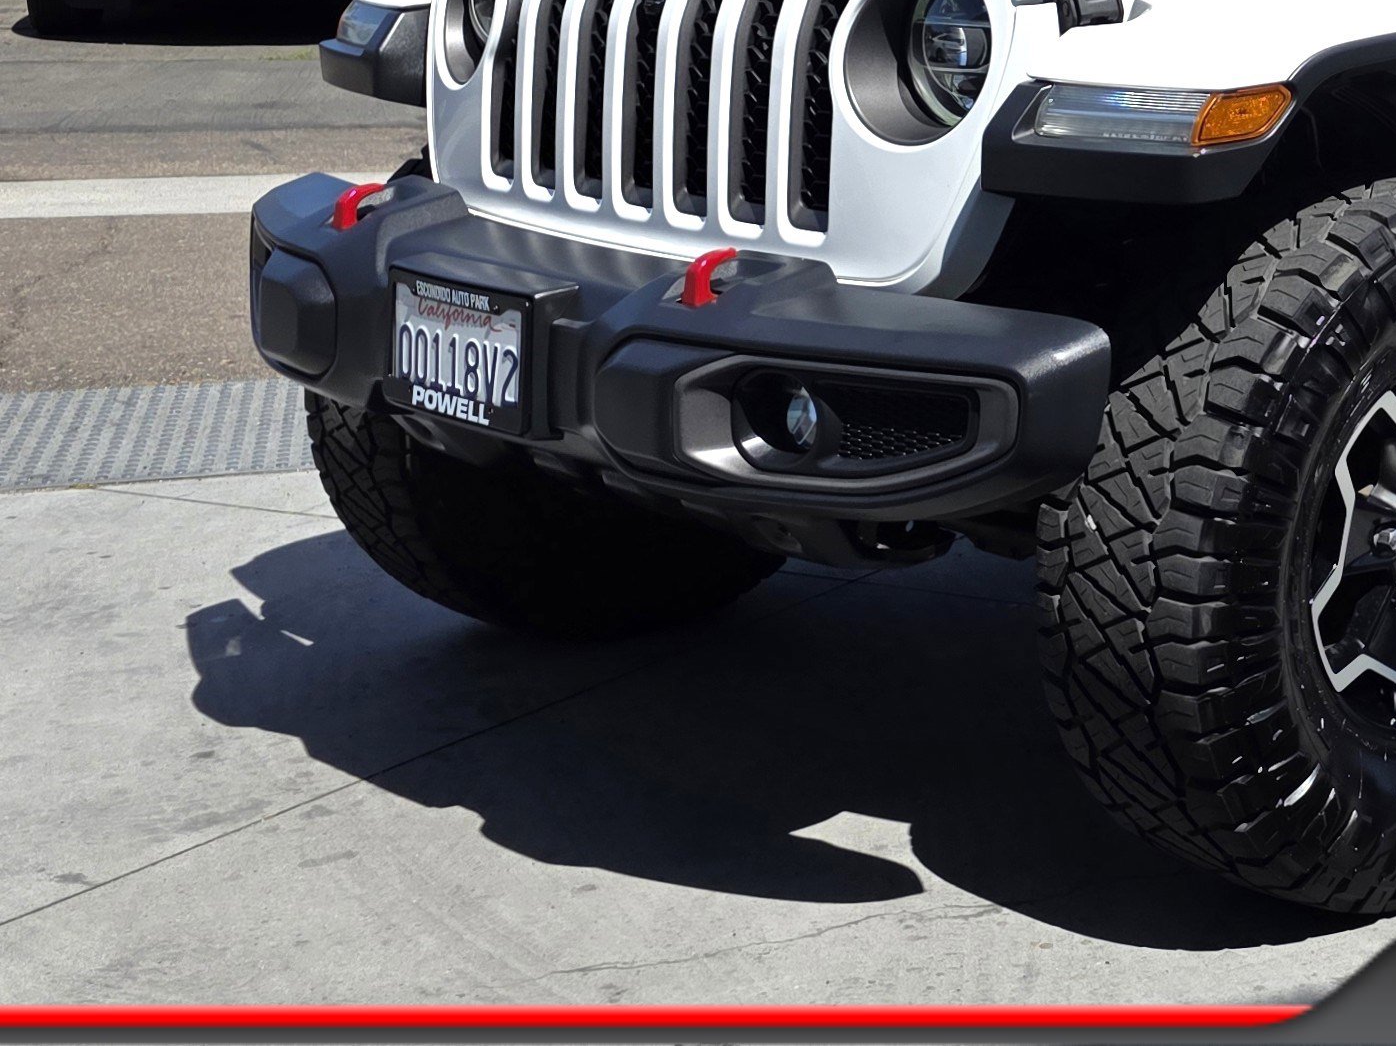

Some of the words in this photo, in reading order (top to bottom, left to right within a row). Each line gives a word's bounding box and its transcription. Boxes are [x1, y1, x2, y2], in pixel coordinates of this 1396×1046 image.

[415, 279, 451, 303] ESCONDIDO
[451, 288, 470, 307] AUTO
[470, 293, 490, 312] PARK
[417, 295, 503, 331] California
[399, 320, 519, 408] 00118V2
[411, 384, 490, 426] POWELL
